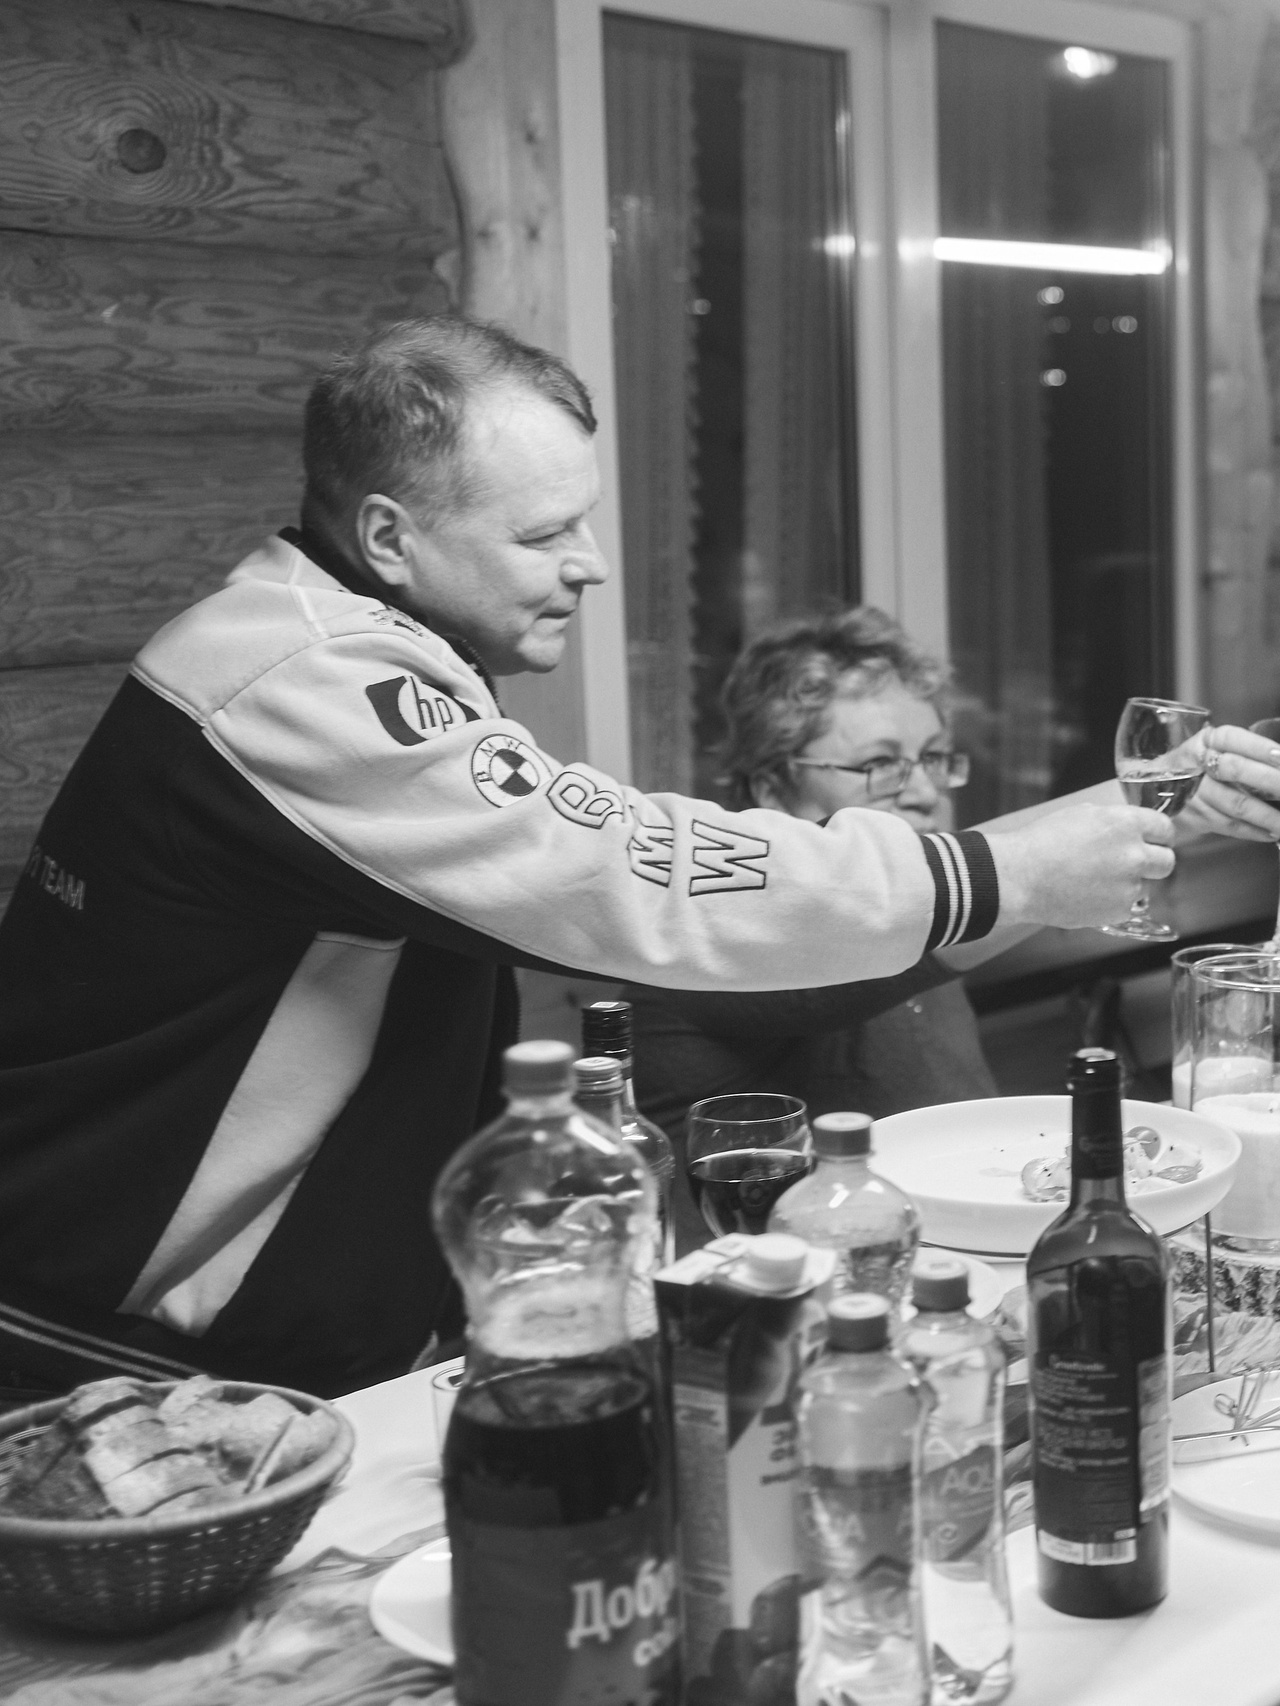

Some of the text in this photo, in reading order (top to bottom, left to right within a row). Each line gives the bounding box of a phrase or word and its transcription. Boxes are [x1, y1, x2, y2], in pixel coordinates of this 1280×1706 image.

[409, 675, 453, 732] hp
[473, 736, 522, 783] BMW
[546, 771, 769, 897] BMW
[40, 855, 86, 910] TEAM
